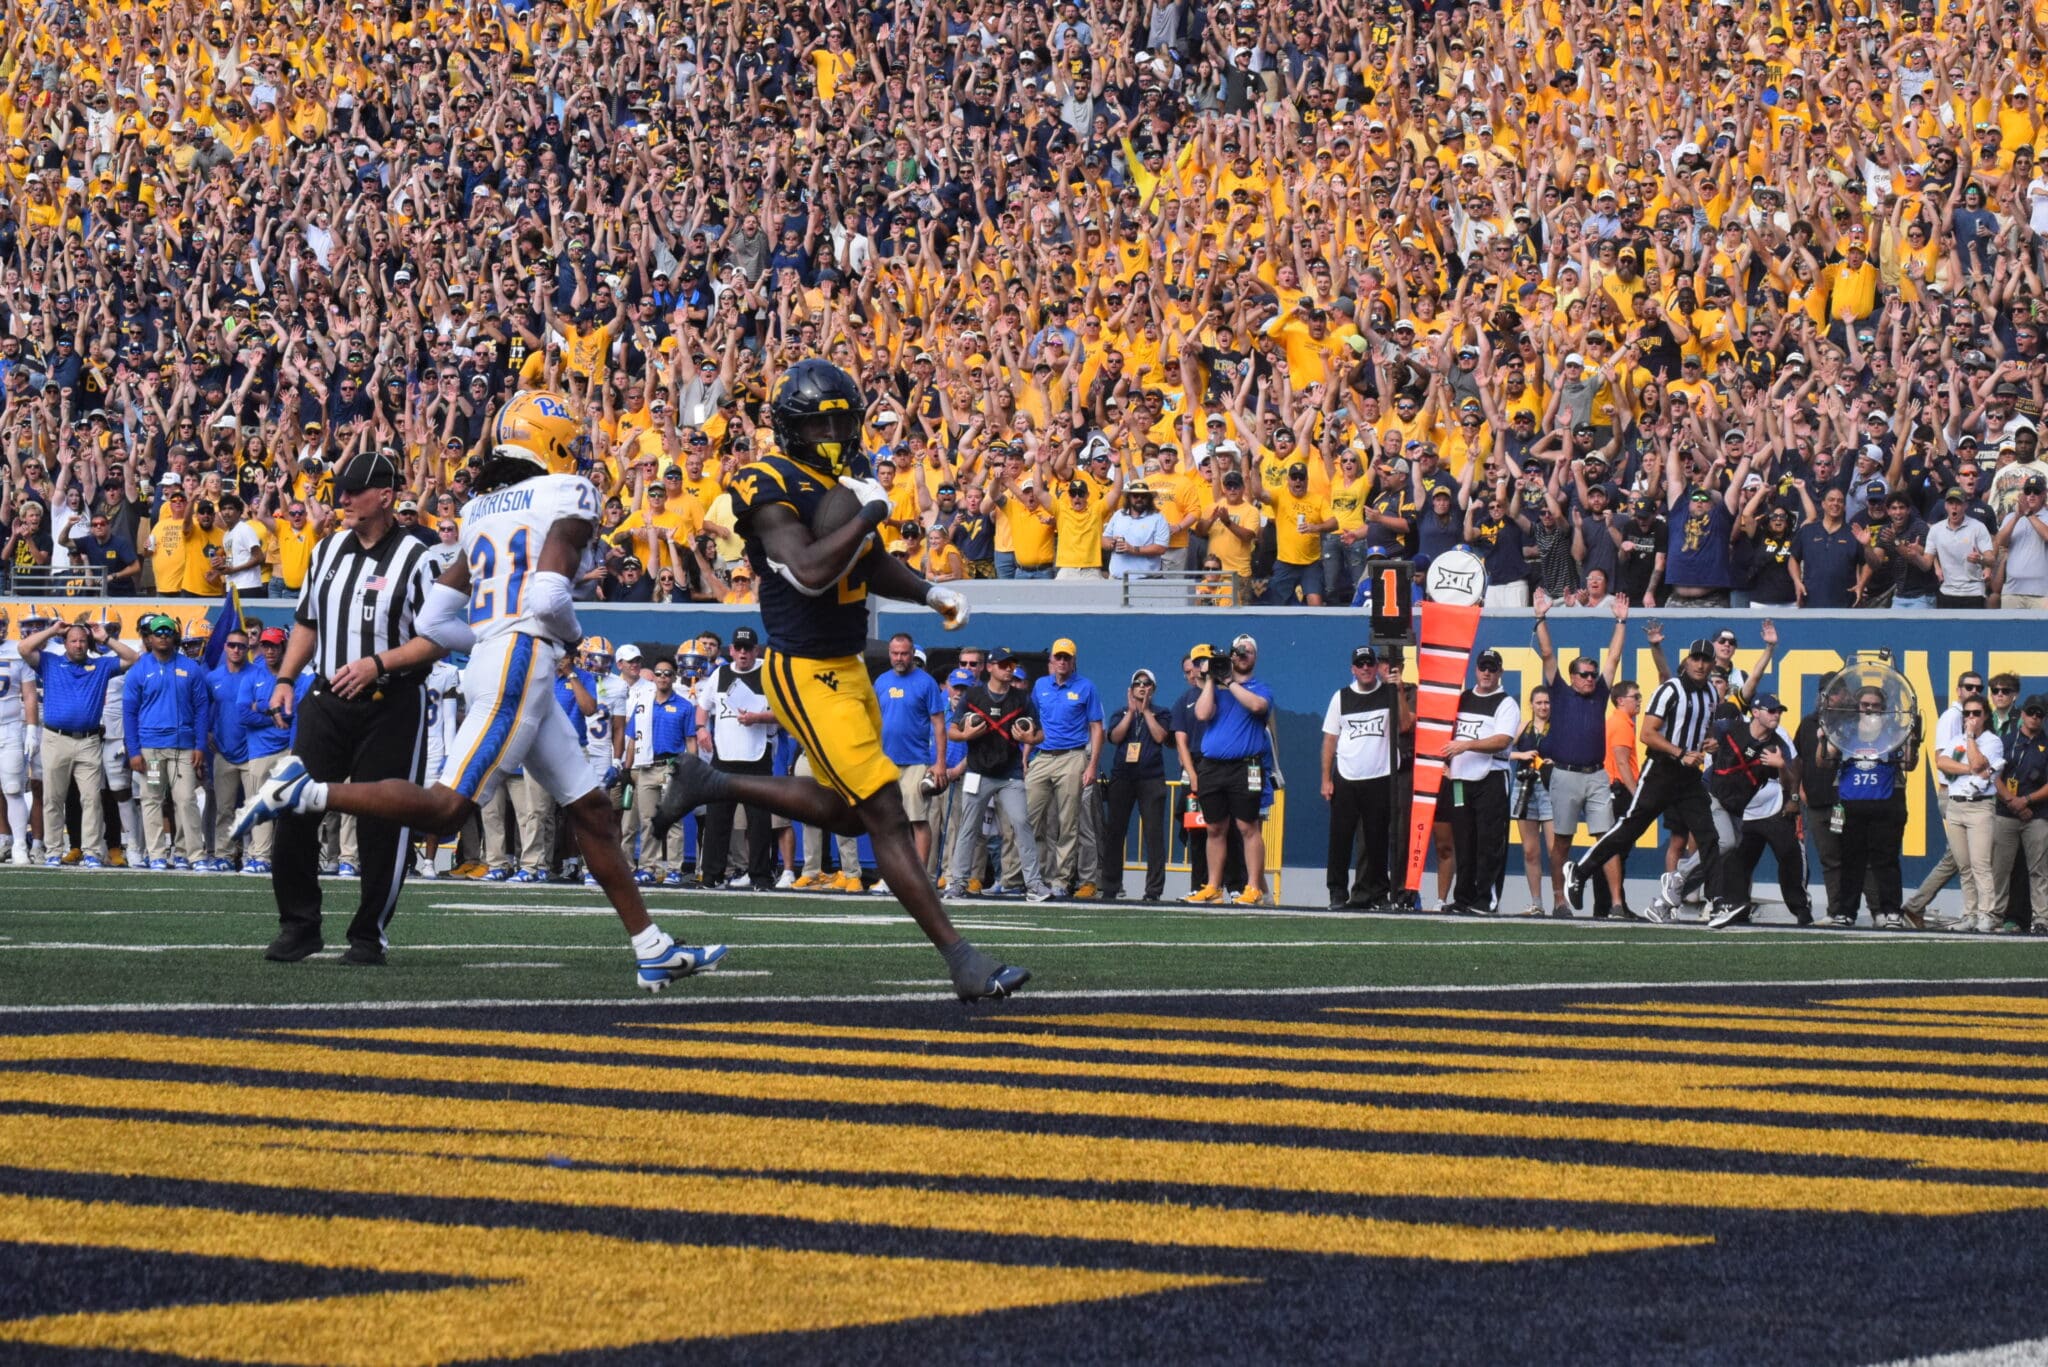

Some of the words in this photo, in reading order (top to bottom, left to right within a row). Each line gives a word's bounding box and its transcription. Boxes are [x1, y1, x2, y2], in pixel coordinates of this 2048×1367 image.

[468, 489, 535, 525] HARRISON
[575, 483, 599, 514] 21
[468, 526, 531, 628] 21
[1381, 569, 1400, 617] 1
[363, 605, 375, 621] U
[1853, 773, 1878, 786] 375
